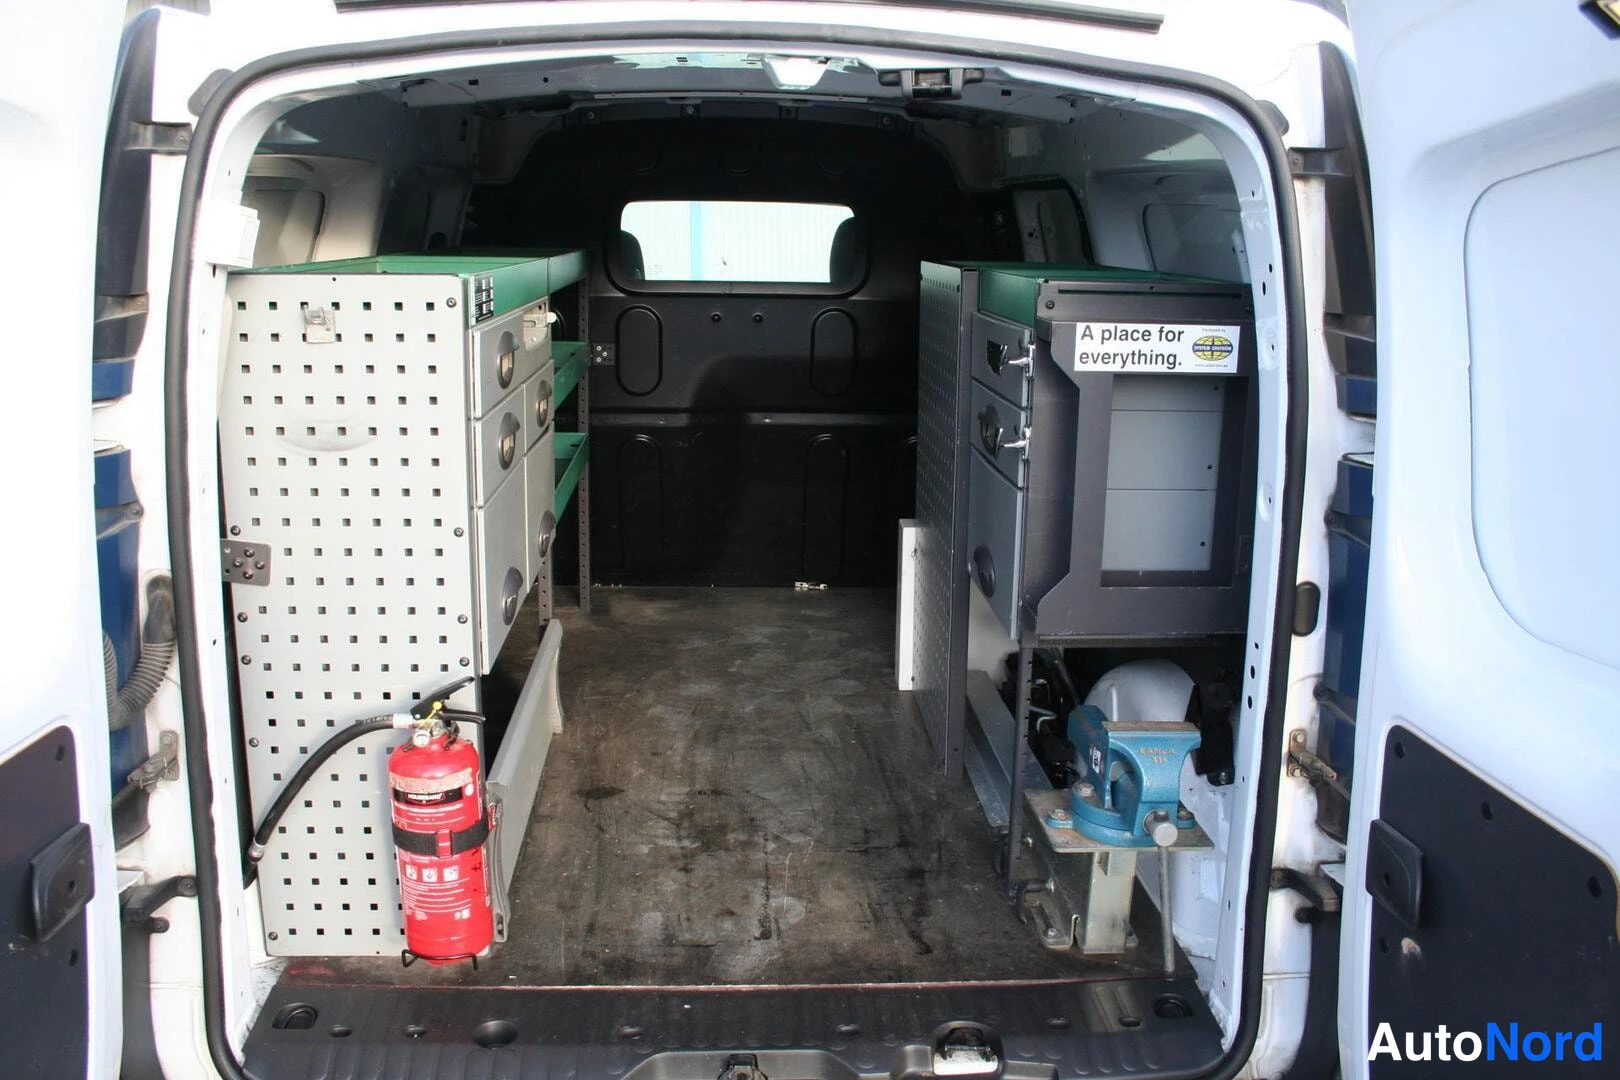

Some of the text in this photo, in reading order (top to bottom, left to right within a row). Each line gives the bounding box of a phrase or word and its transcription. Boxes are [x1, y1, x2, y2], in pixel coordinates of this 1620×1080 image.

[1080, 324, 1185, 345] A place for
[1079, 349, 1182, 370] everything.
